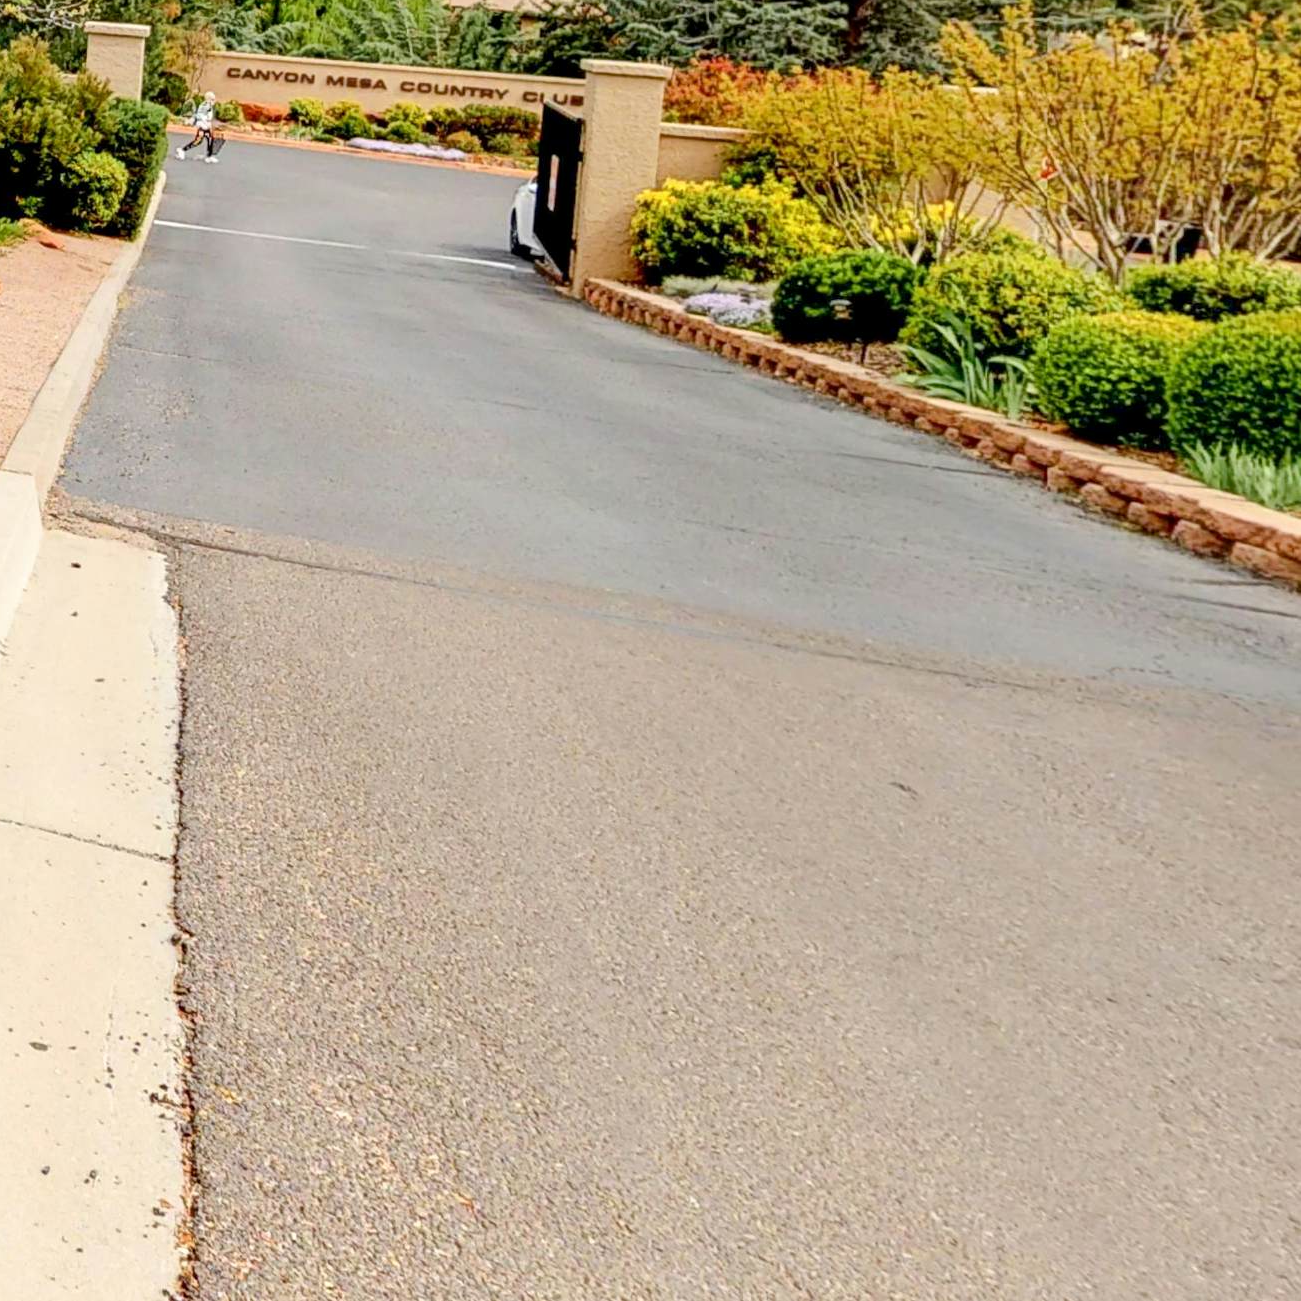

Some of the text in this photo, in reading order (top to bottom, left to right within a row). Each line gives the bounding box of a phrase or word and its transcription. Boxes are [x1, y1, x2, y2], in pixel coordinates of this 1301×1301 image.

[227, 67, 584, 107] CANYON MESA COUNTRY CLUB
